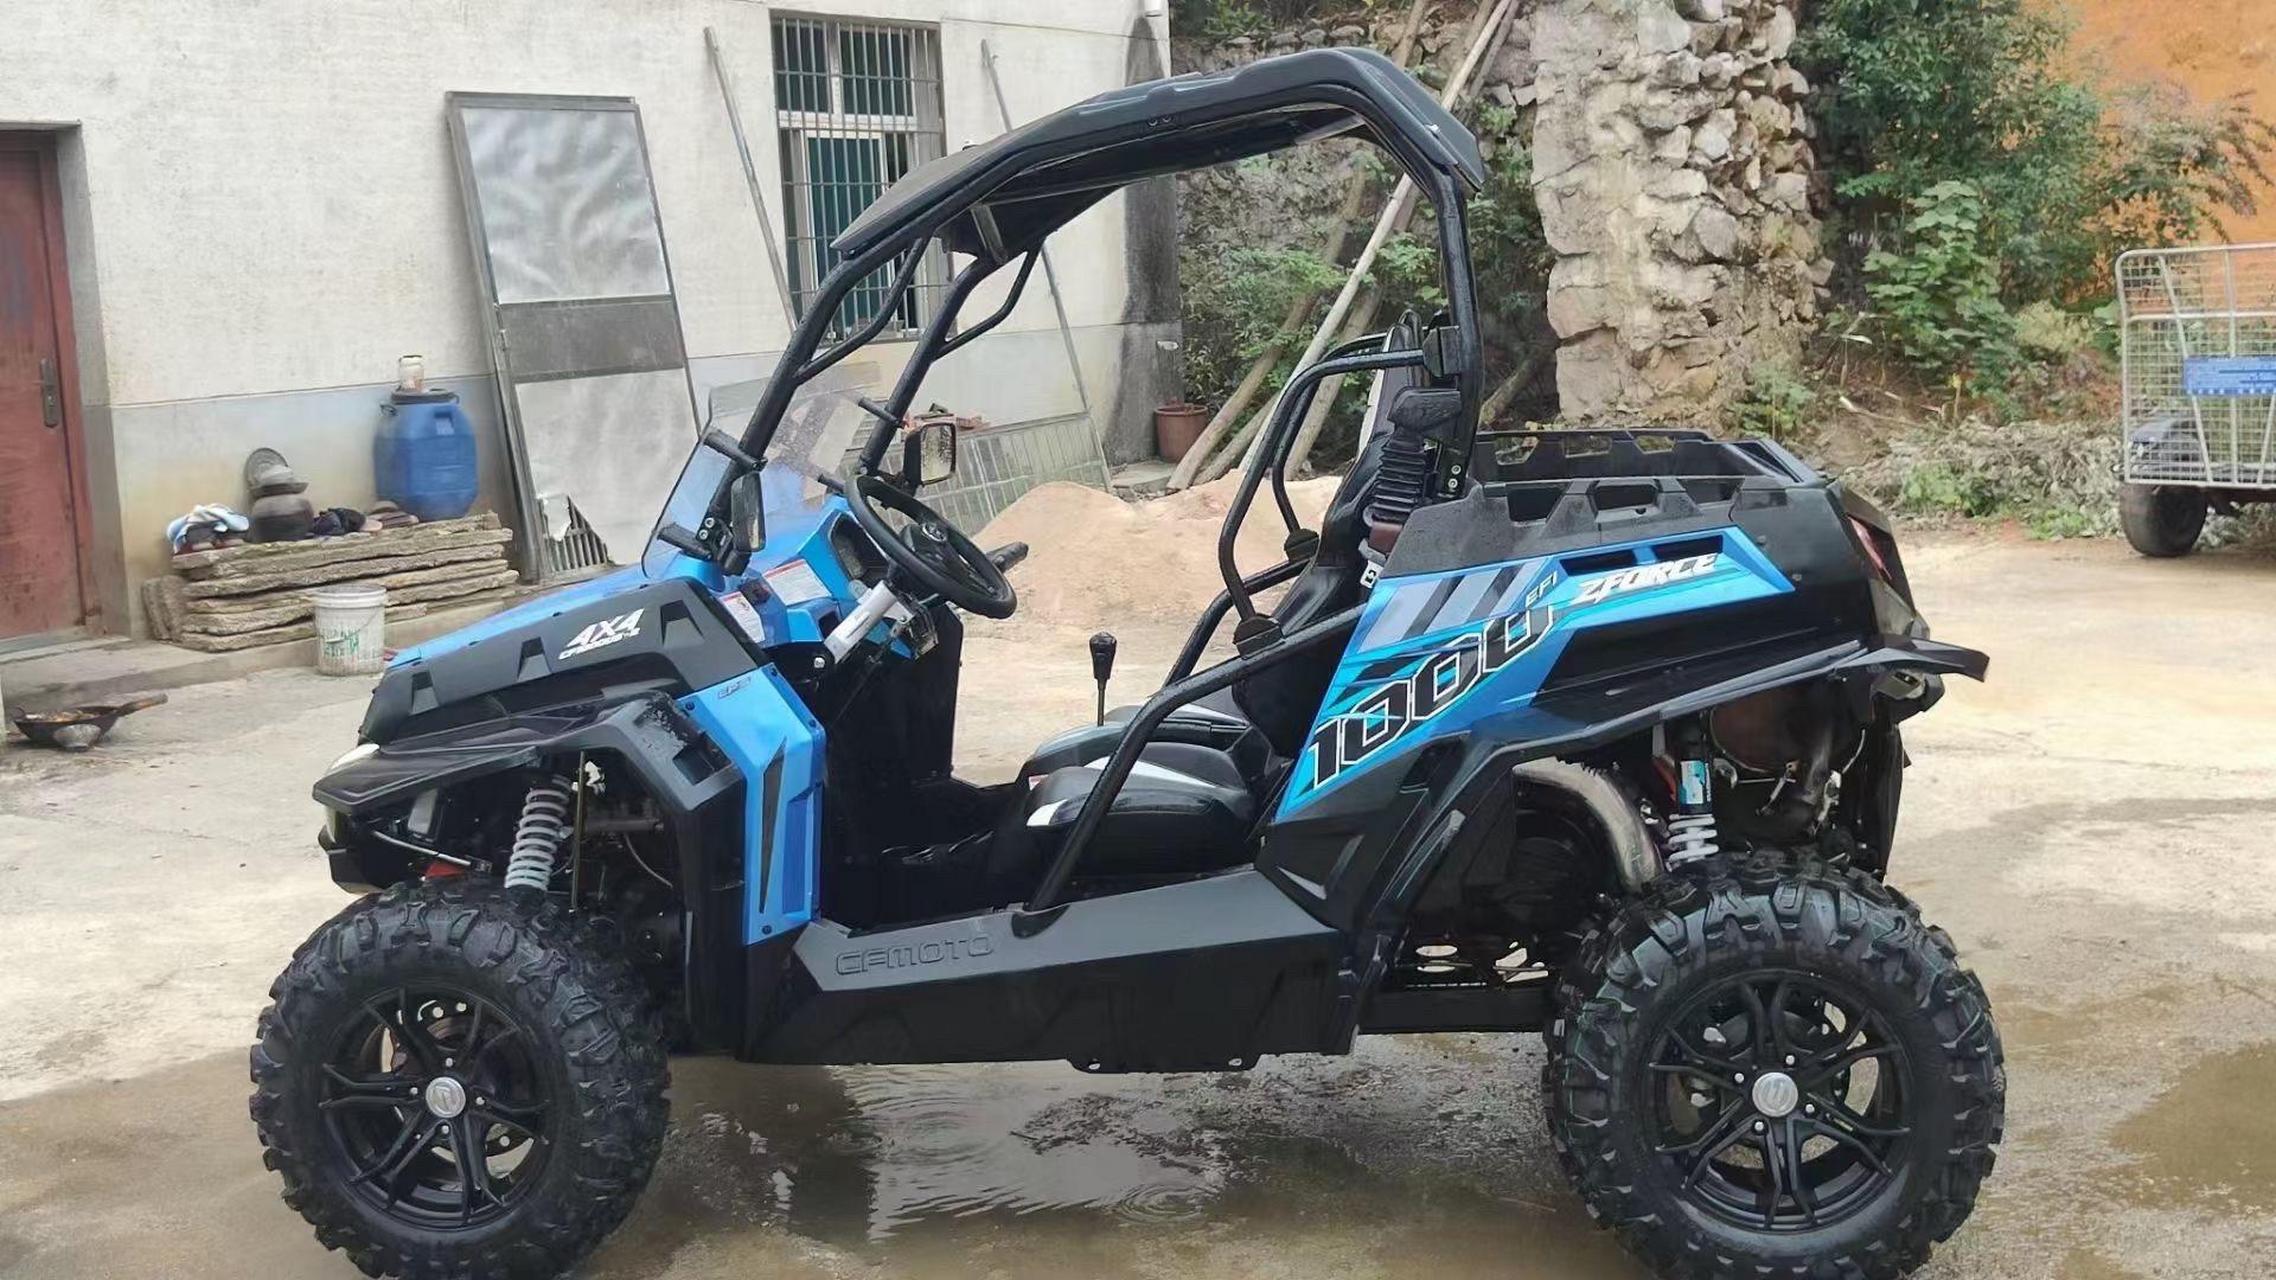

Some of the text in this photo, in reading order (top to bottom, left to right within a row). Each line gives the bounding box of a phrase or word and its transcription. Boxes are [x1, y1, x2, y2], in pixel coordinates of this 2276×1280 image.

[1525, 571, 1558, 608] EFI
[1569, 552, 1719, 604] ZFORCE
[564, 608, 645, 647] 4X4
[836, 933, 994, 975] CFMOTO
